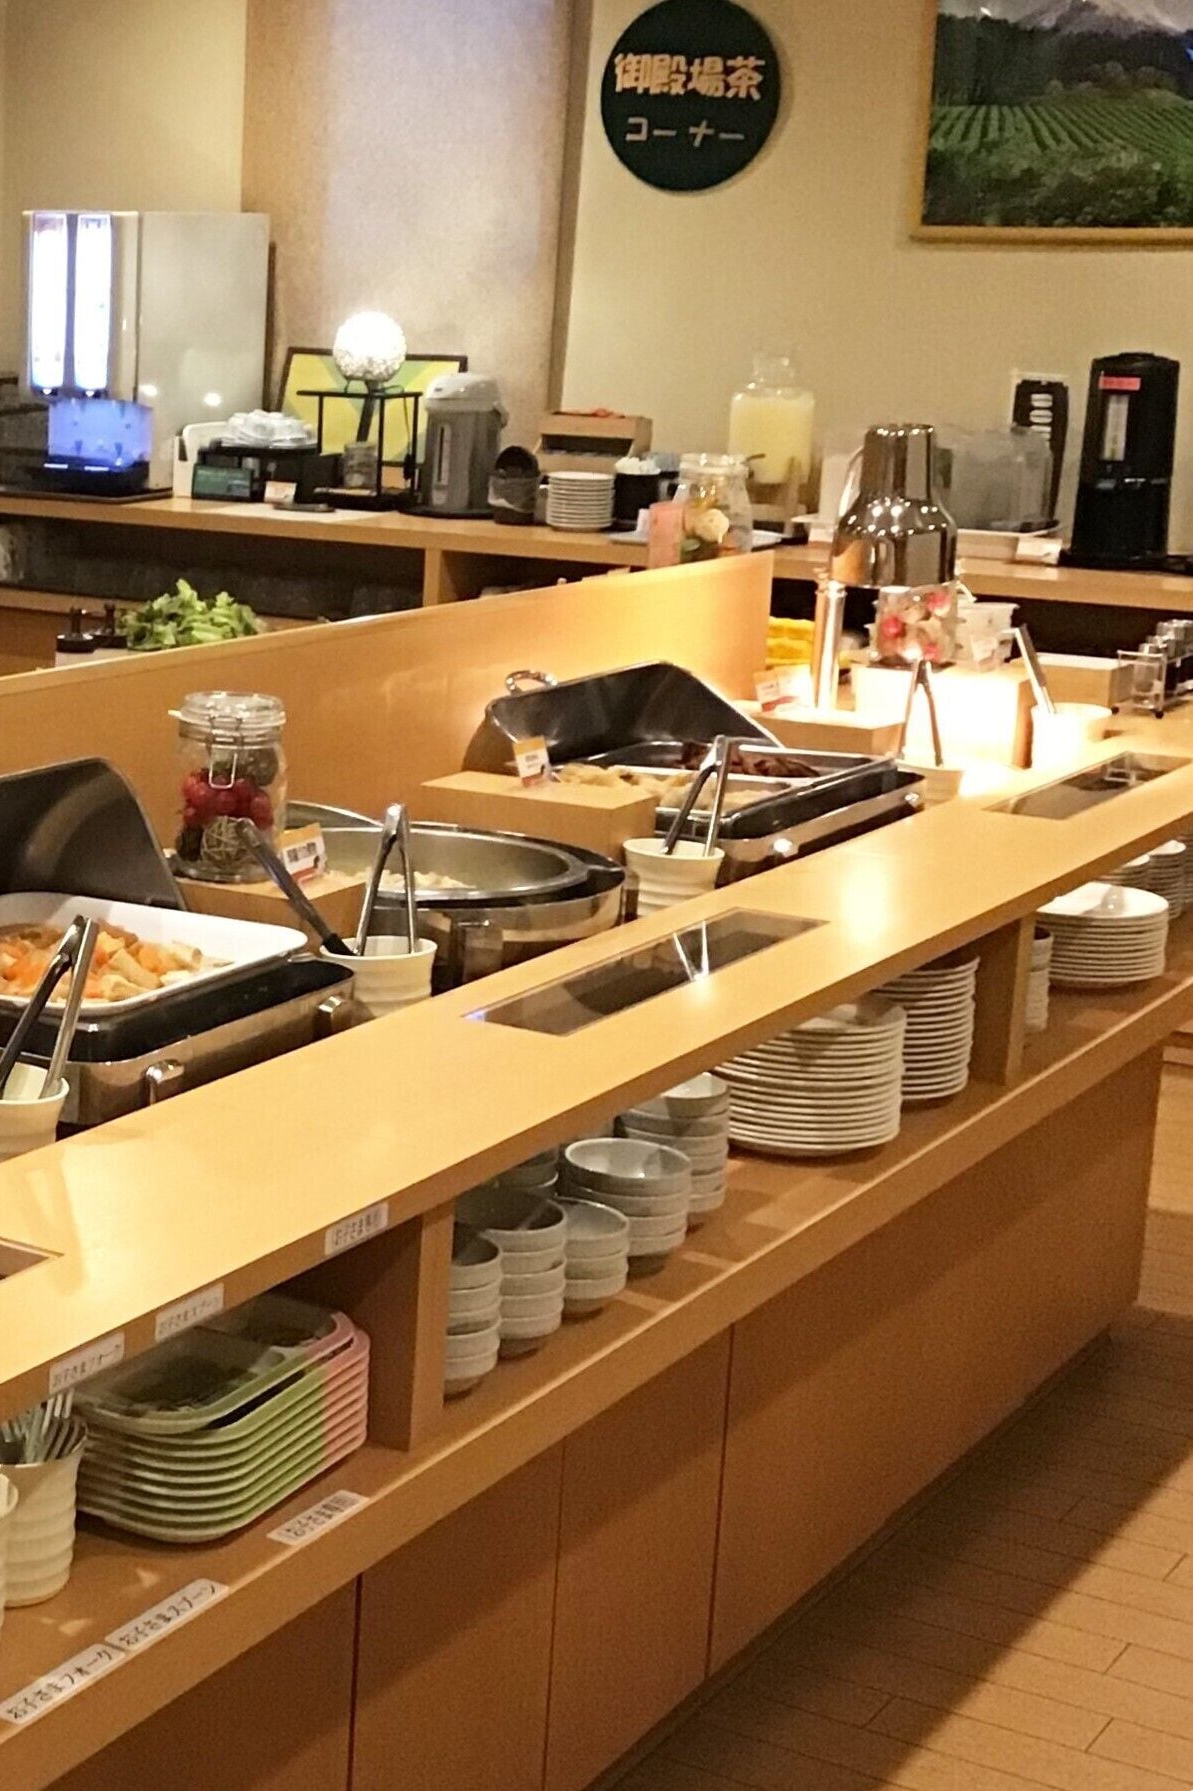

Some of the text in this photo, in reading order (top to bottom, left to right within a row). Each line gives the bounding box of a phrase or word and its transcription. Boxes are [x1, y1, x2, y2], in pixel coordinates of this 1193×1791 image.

[614, 53, 766, 100] 御殿場茶
[625, 117, 745, 147] コーナー
